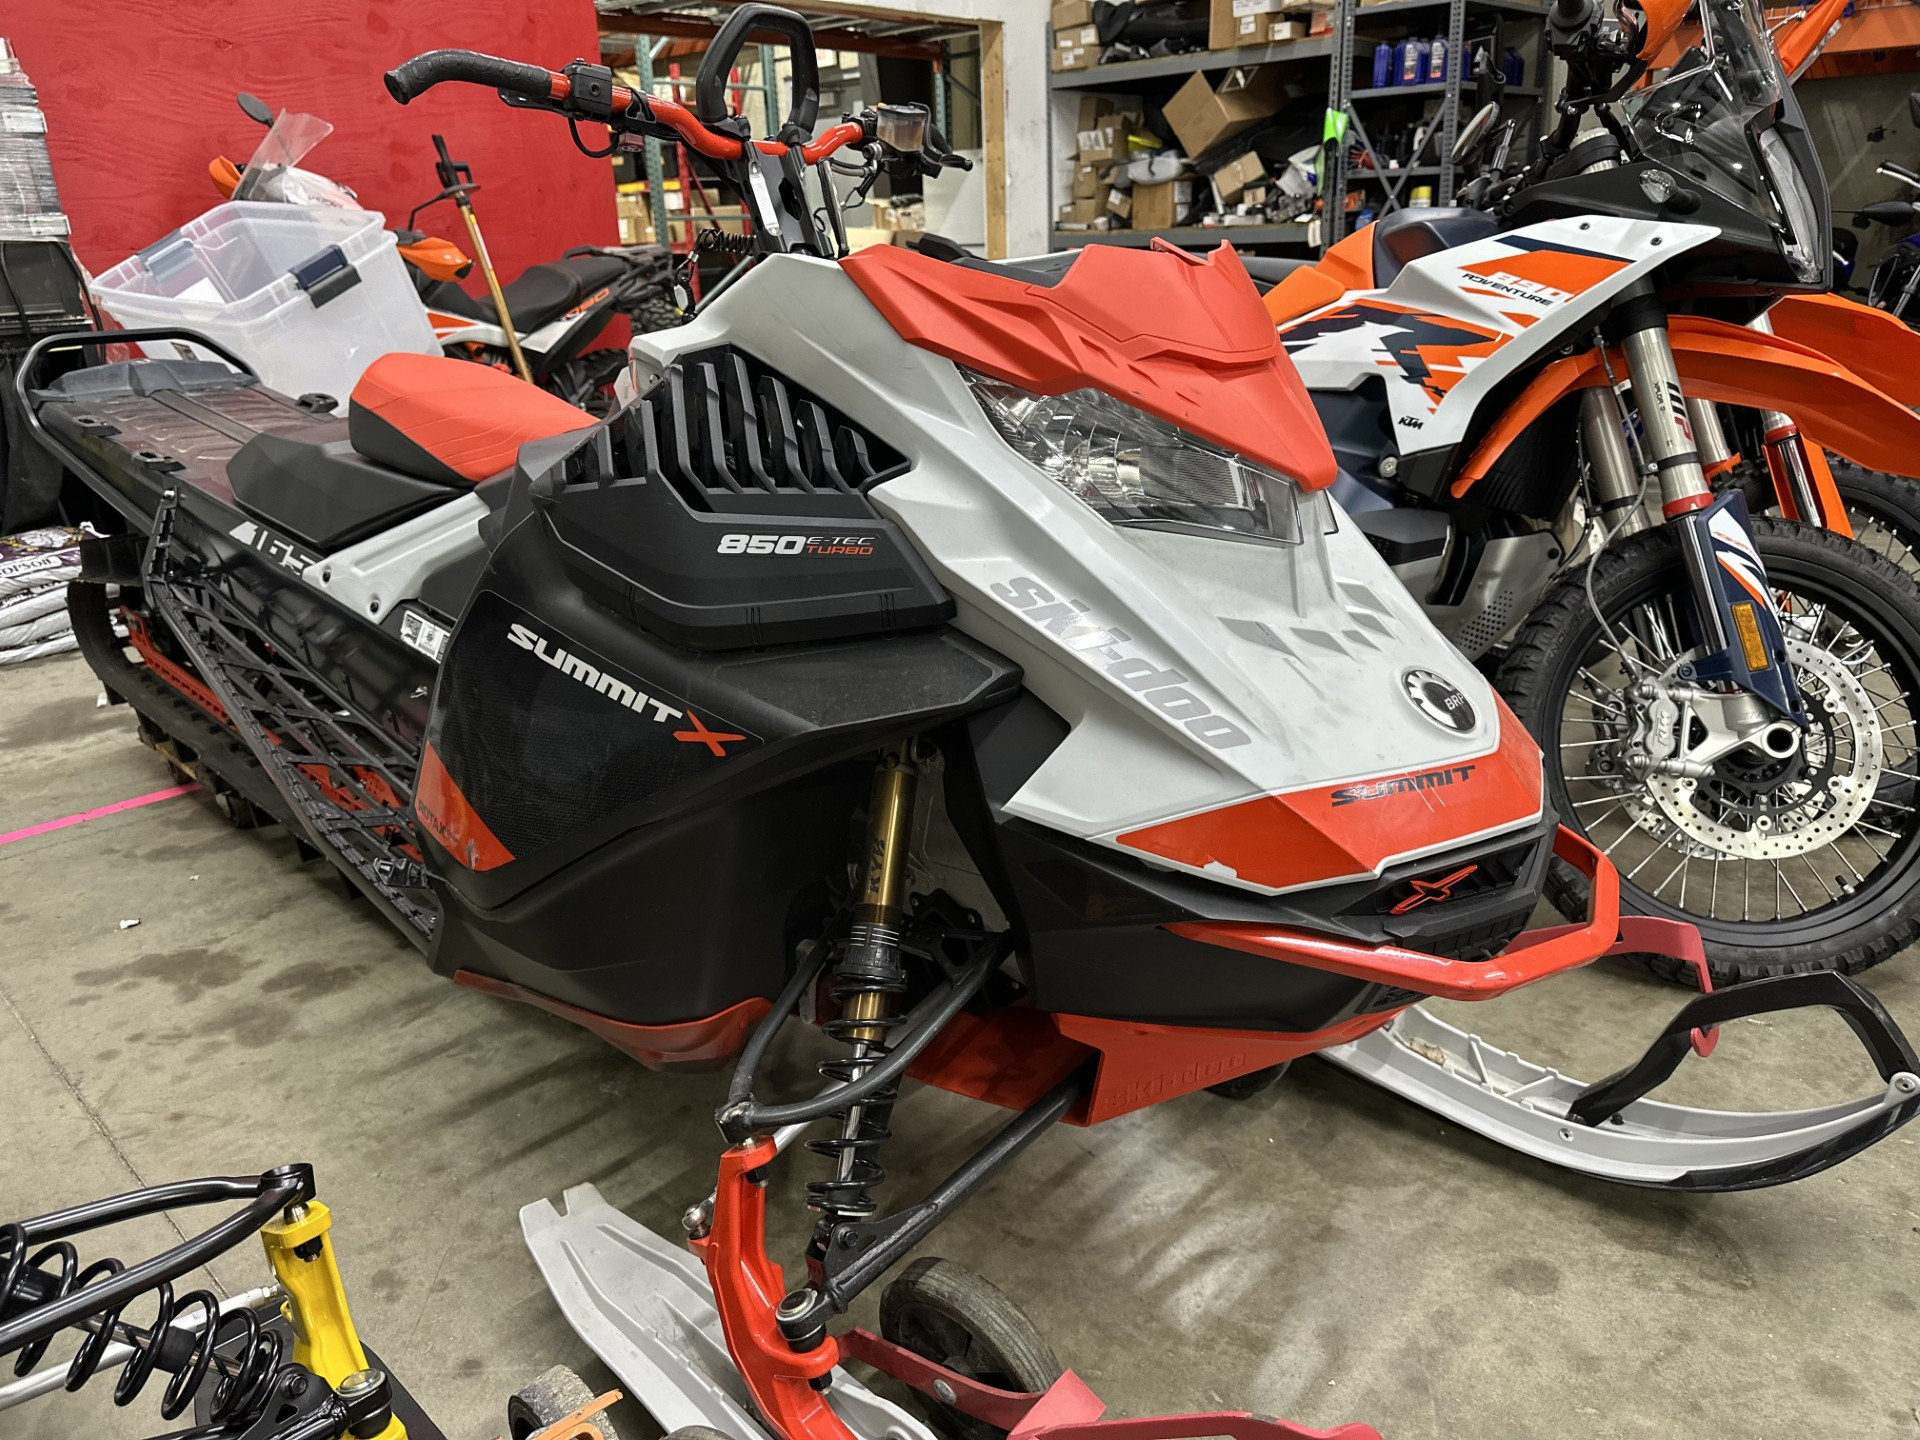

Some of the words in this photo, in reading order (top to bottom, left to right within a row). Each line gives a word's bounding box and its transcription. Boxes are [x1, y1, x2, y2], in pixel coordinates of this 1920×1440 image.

[1462, 273, 1554, 307] ADVENTURE
[1398, 415, 1424, 430] KTM
[717, 534, 807, 555] 850
[806, 536, 875, 546] E-TEC
[806, 545, 873, 555] TURBO
[506, 623, 684, 723] SUMMIT
[672, 709, 747, 756] X
[1444, 692, 1465, 711] BRP
[1330, 764, 1476, 807] SUMMIT
